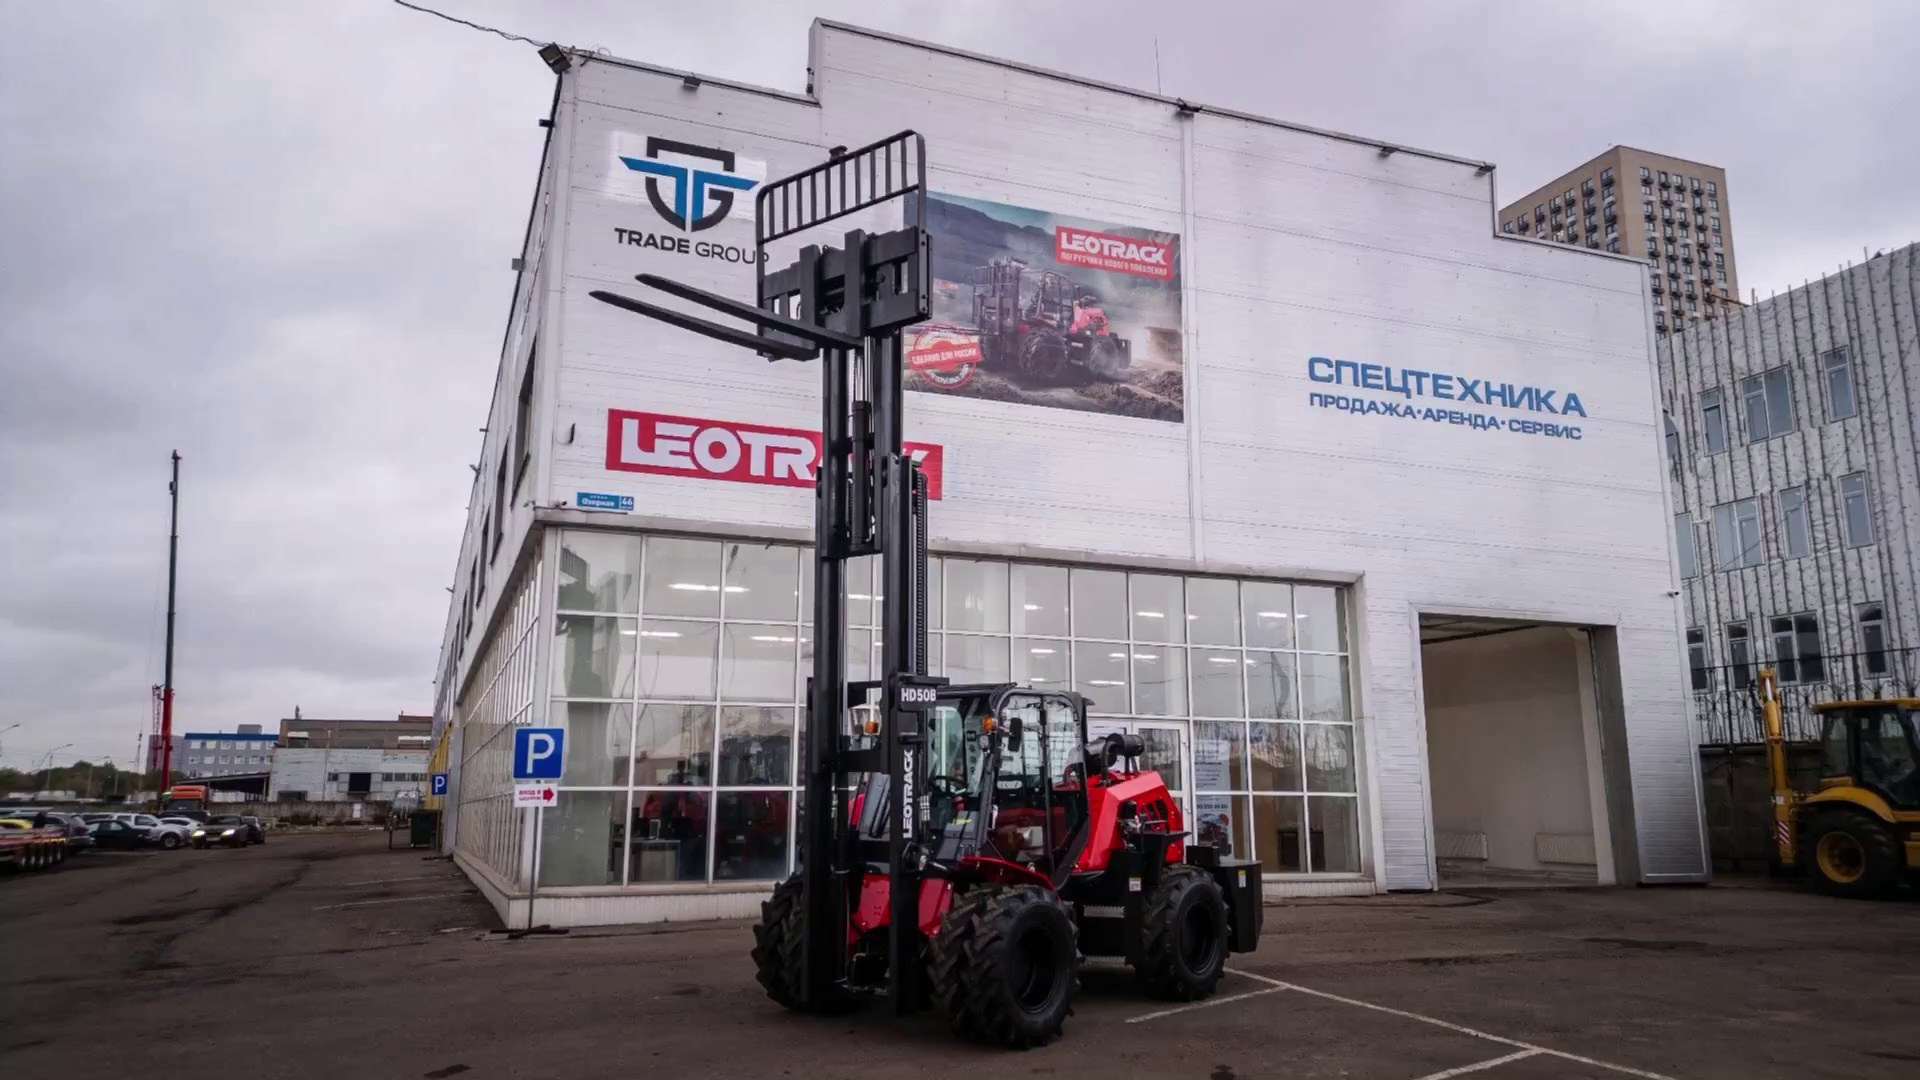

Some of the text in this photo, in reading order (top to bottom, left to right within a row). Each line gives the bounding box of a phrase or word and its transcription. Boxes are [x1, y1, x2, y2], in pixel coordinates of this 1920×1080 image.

[614, 227, 690, 254] TRADE
[1061, 232, 1167, 265] LEOTRACK
[1308, 357, 1587, 417] СПЕЦТЕХНИКА
[620, 417, 930, 492] LEOTR
[622, 497, 633, 506] 46
[901, 688, 937, 702] HD50B
[527, 733, 555, 774] P
[435, 776, 445, 793] P
[902, 748, 914, 839] LEOTRACK
